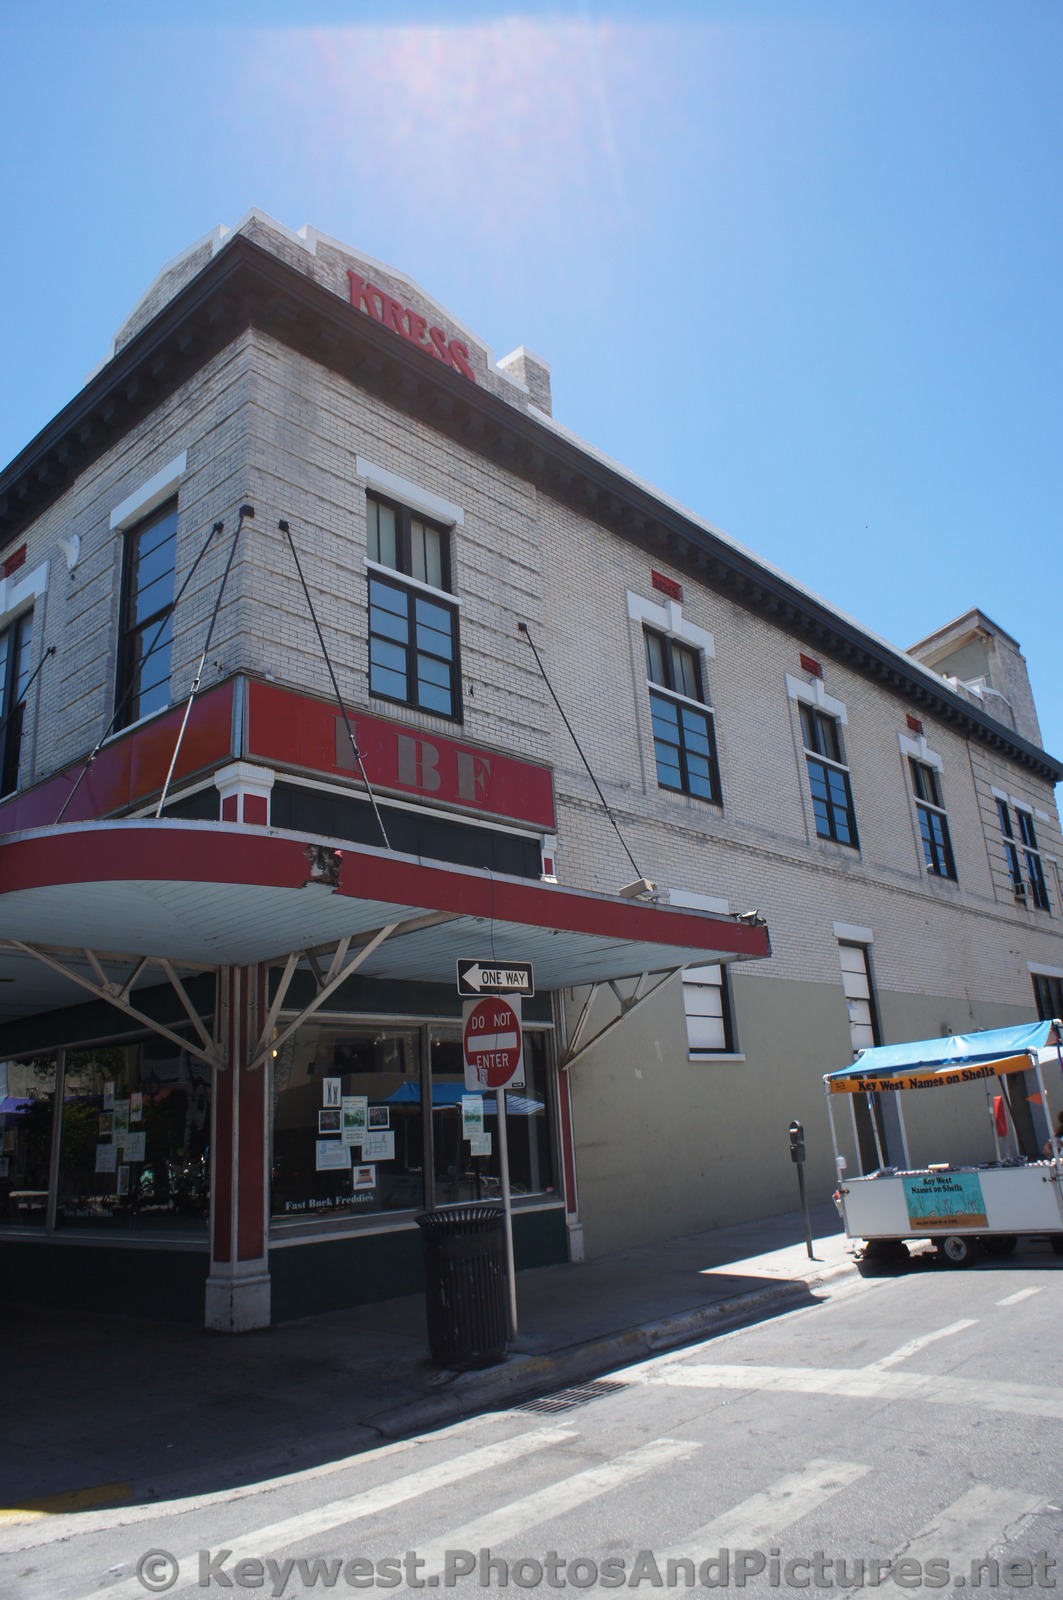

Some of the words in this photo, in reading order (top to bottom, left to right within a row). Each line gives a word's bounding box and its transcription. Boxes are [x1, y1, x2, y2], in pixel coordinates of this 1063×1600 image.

[346, 269, 476, 384] KRESS
[482, 971, 502, 985] ONE
[505, 972, 526, 985] WAY
[471, 1016, 485, 1030] DO
[493, 1011, 512, 1027] NOT
[476, 1053, 510, 1069] ENTER
[858, 1081, 877, 1092] Key
[880, 1080, 904, 1091] West
[908, 1078, 944, 1089] Names
[946, 1075, 960, 1085] on
[962, 1066, 995, 1081] Shells
[911, 1186, 932, 1194] Names
[943, 1184, 962, 1192] Shells
[923, 1177, 935, 1186] Key
[285, 1200, 306, 1211] Fast
[309, 1197, 333, 1208] Buck
